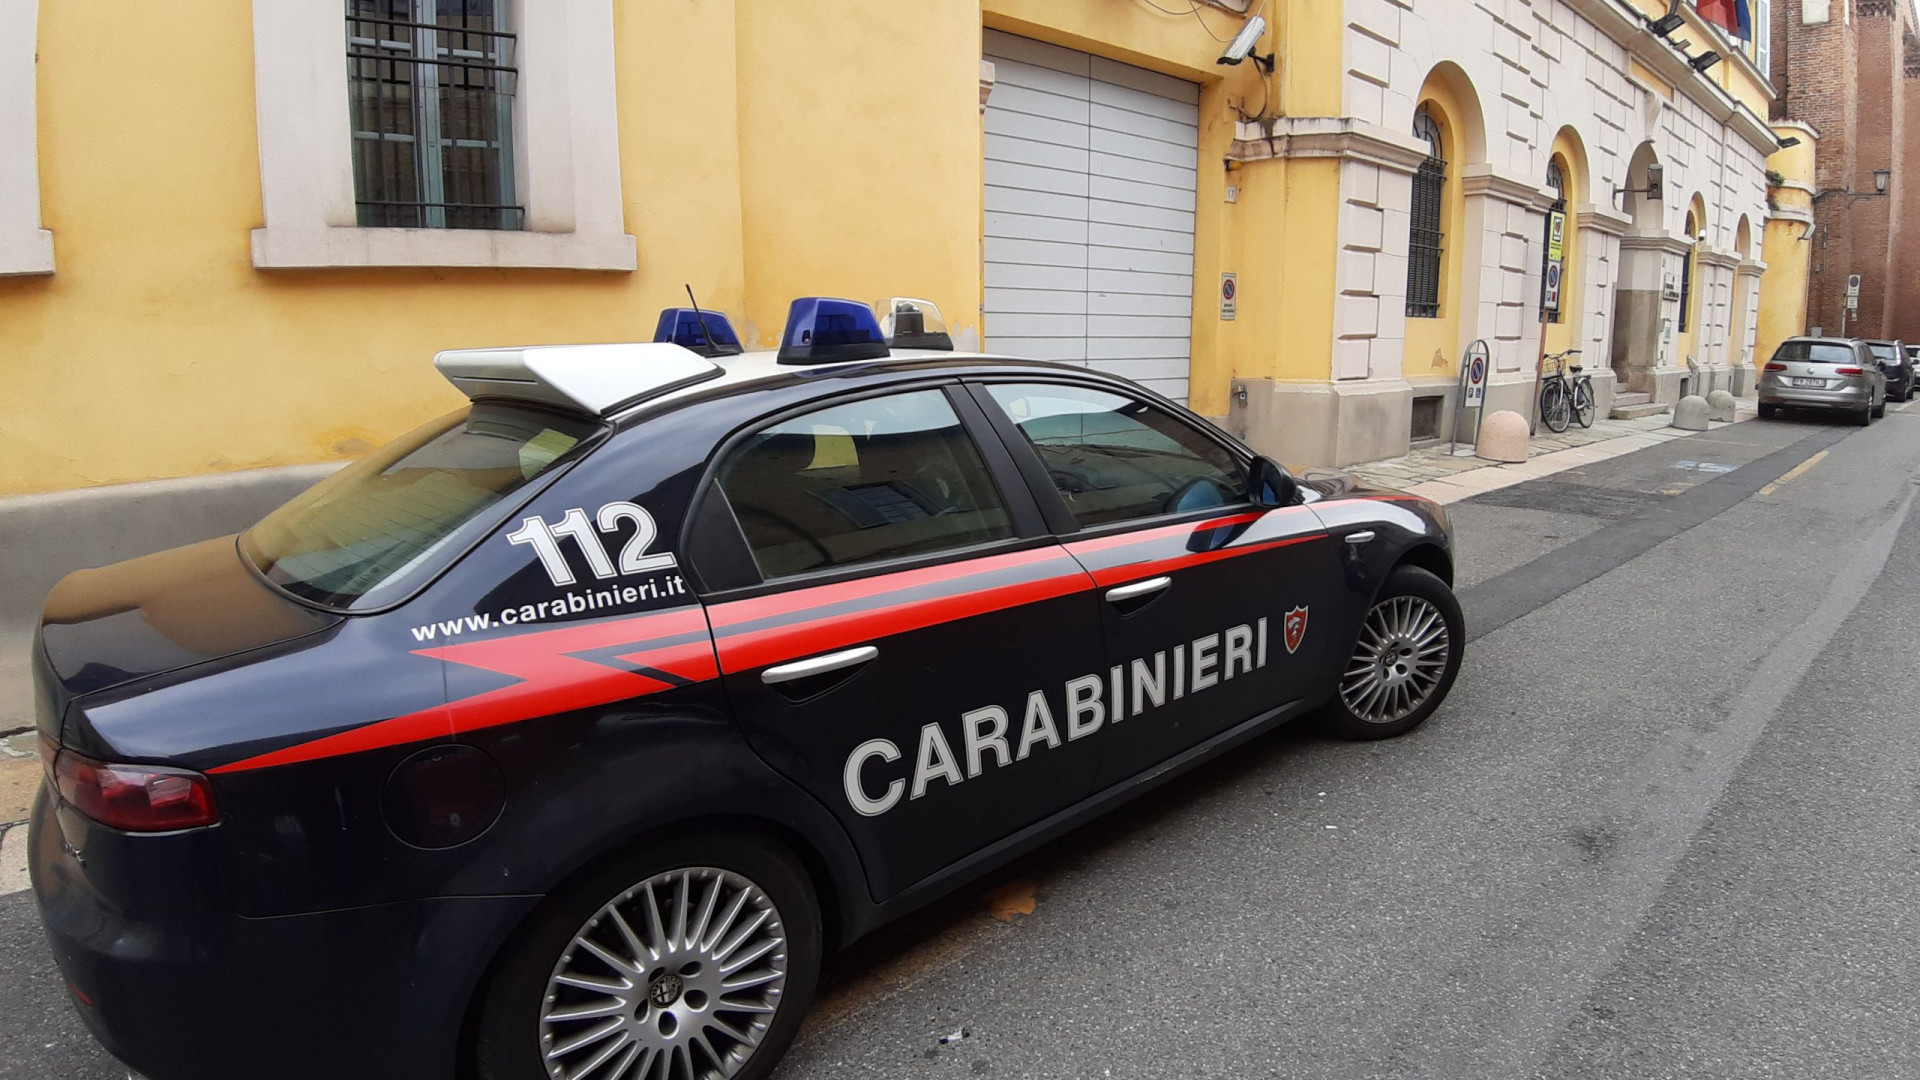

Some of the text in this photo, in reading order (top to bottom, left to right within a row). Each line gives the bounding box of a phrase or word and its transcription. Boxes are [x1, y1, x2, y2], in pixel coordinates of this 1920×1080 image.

[506, 501, 677, 587] 112
[411, 575, 685, 641] www.carabinieri.it
[843, 617, 1267, 816] CARABINIERI
